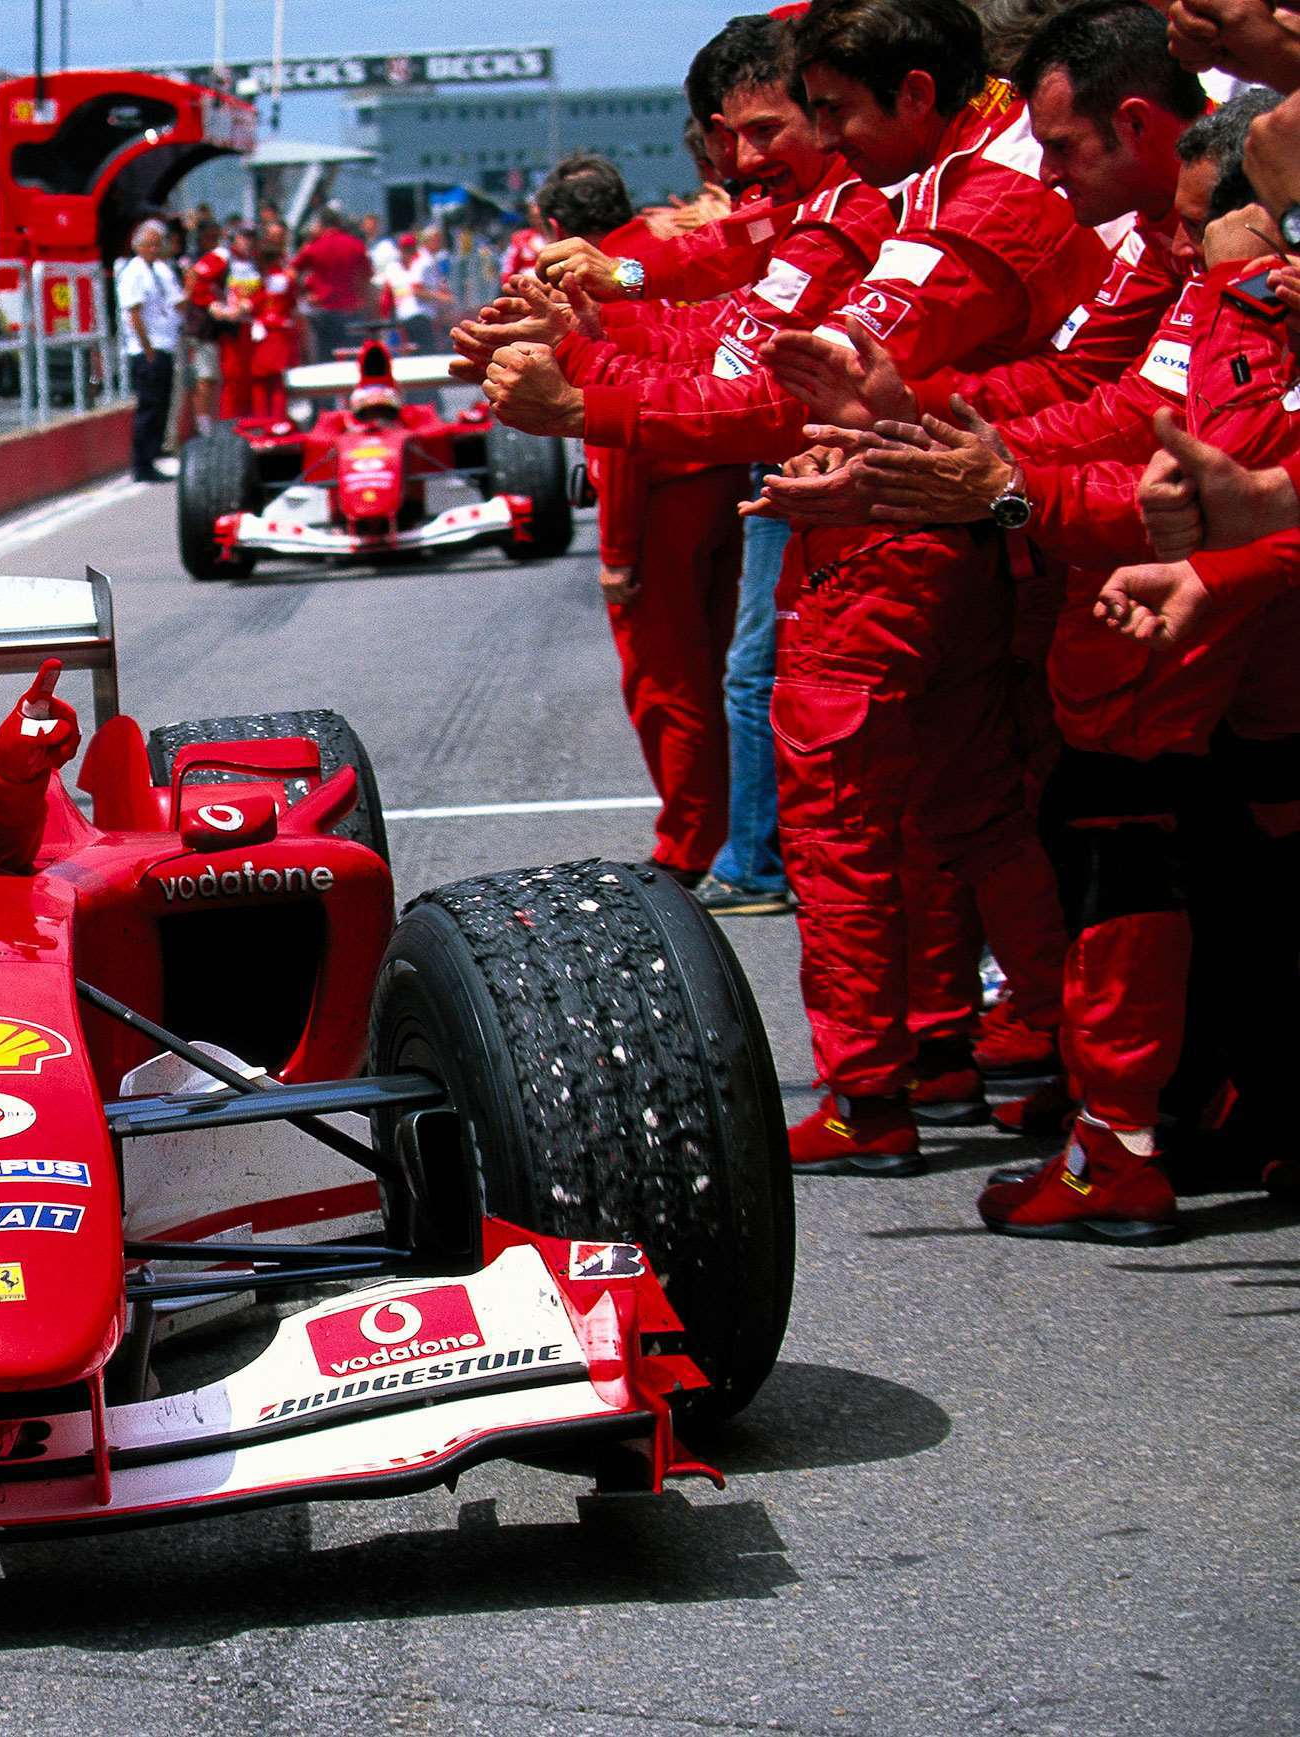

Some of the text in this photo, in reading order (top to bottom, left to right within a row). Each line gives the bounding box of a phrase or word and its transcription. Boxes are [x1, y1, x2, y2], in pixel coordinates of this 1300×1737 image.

[159, 861, 334, 900] vodafone
[330, 1332, 479, 1376] vodafone
[255, 1344, 563, 1424] BRIDGESTONE
